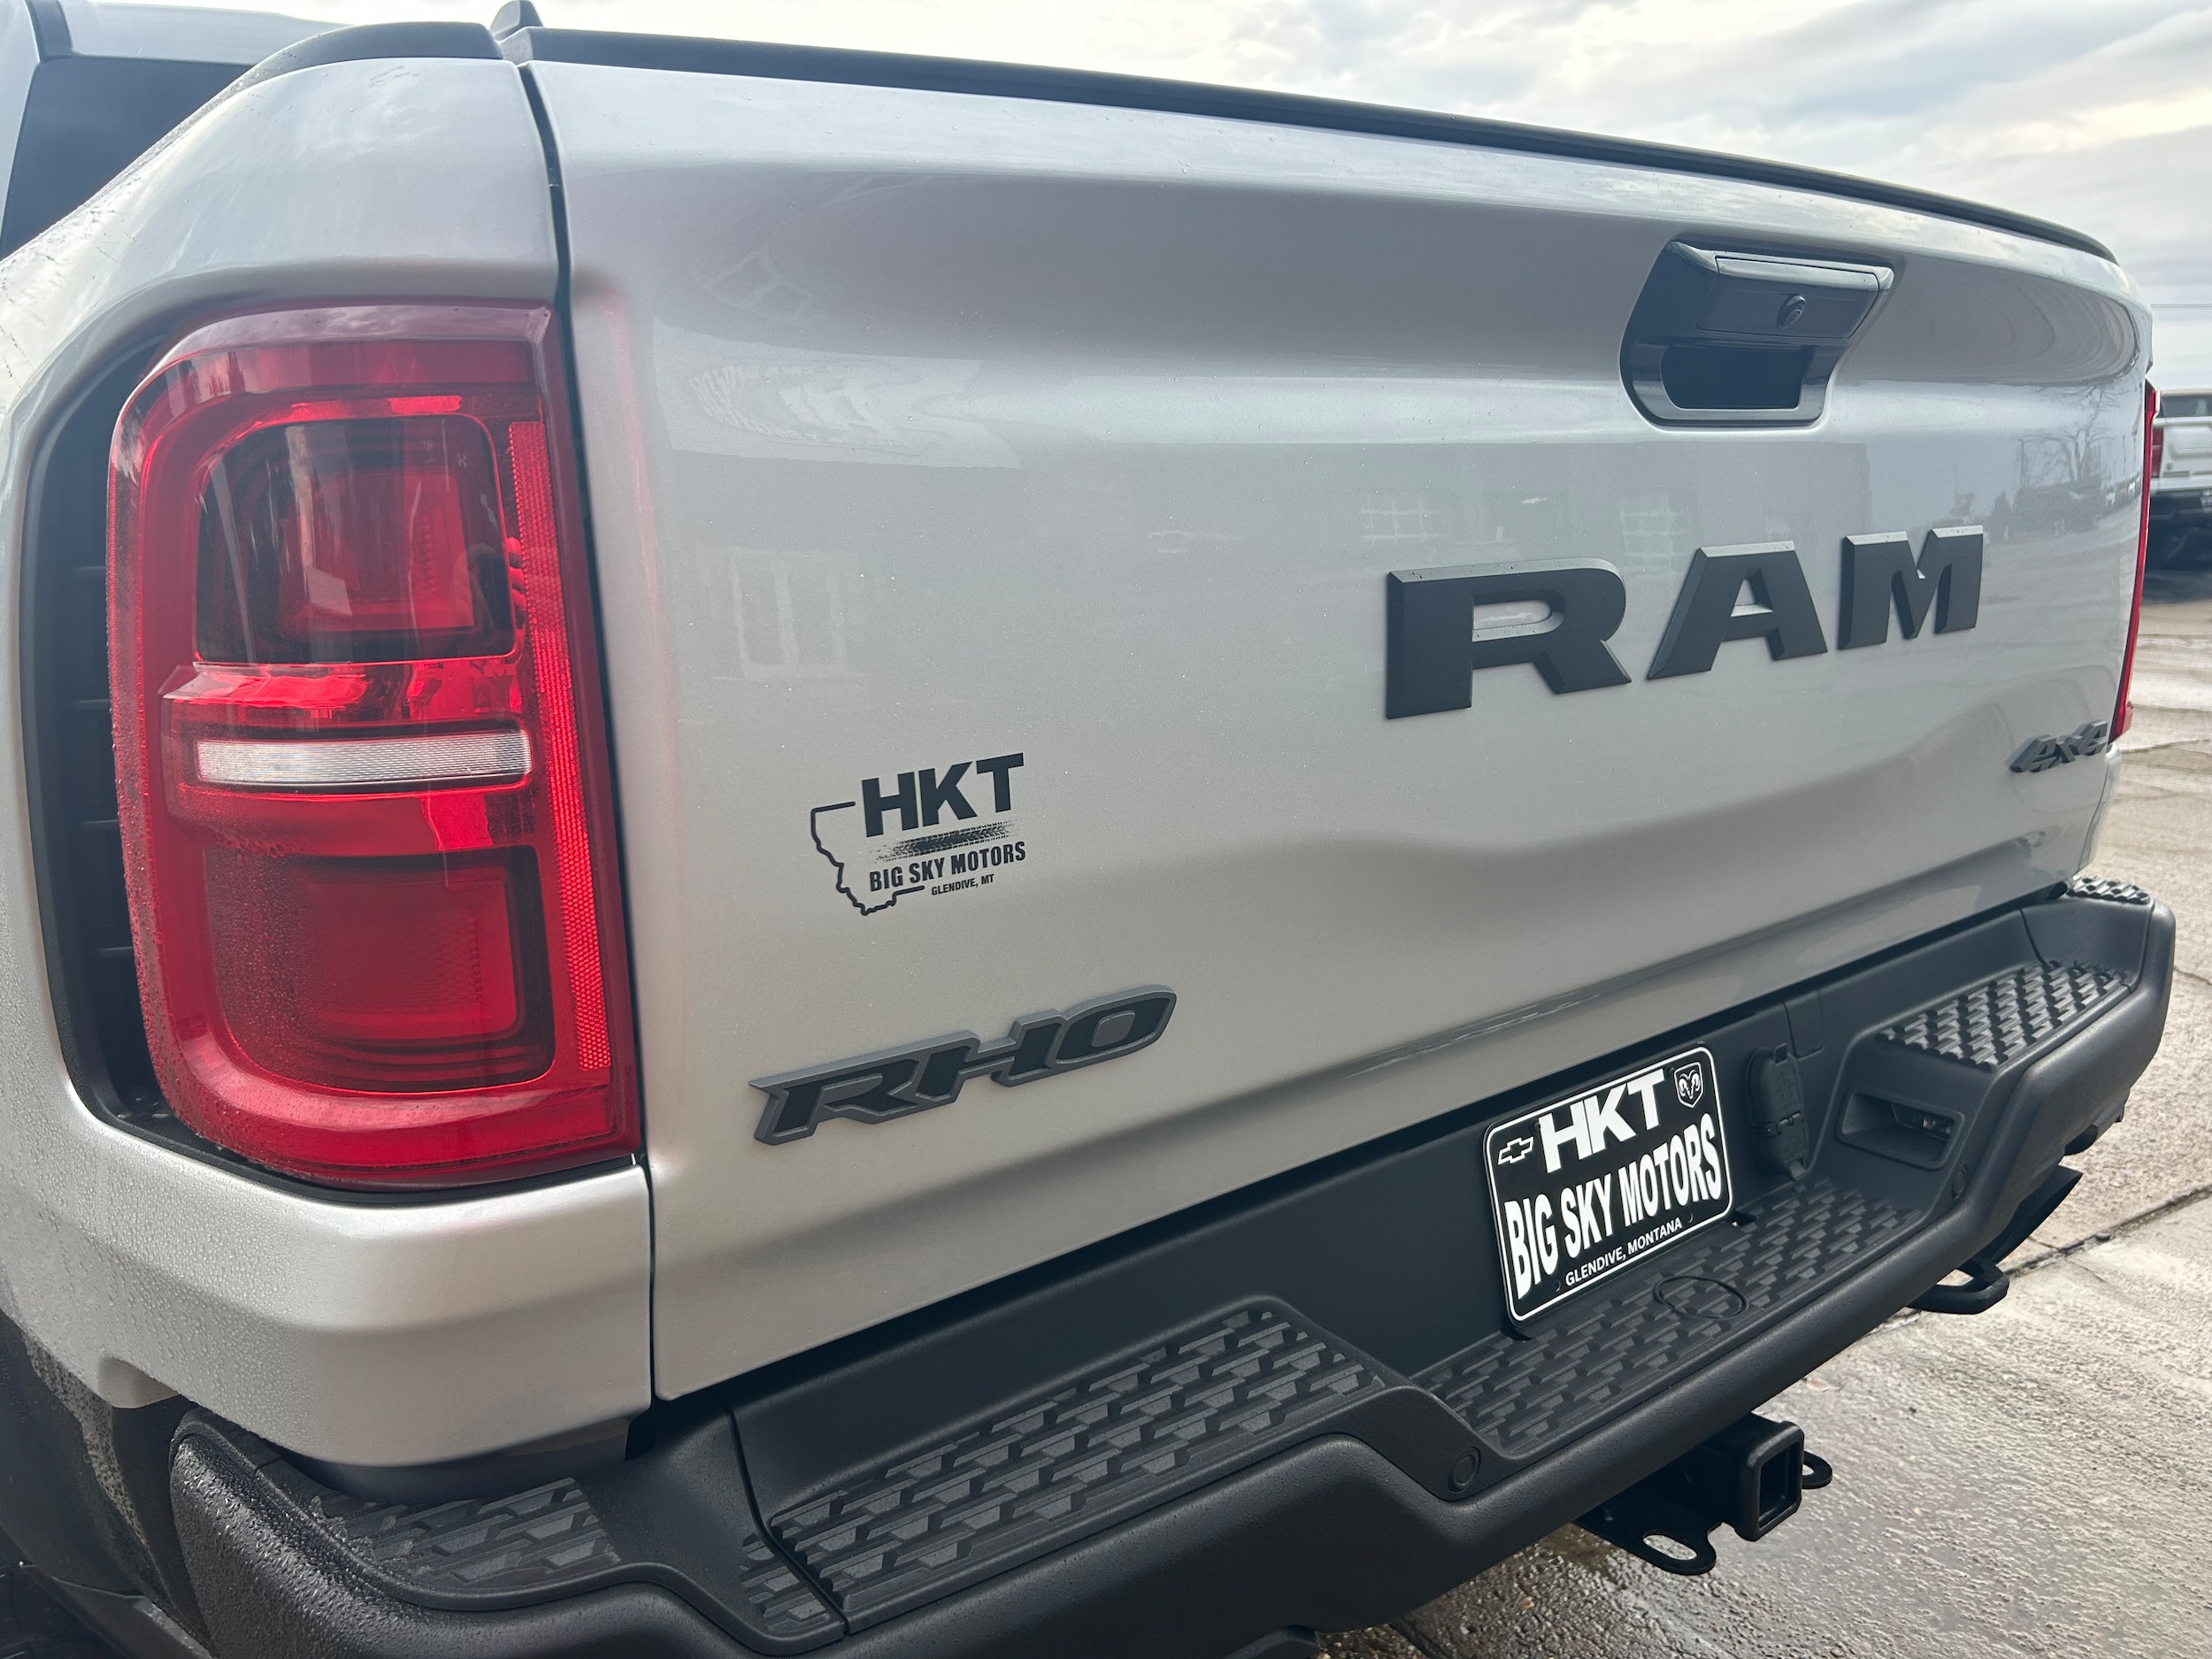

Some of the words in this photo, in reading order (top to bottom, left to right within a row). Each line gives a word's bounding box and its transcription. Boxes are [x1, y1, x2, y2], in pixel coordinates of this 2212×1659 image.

[1386, 525, 1984, 719] RAM
[861, 752, 1025, 838] HKT
[870, 866, 903, 892] BIG
[909, 857, 945, 884] SKY
[950, 841, 1026, 875] MOTORS
[931, 878, 979, 896] GLENDIVE,
[981, 873, 995, 884] MT
[749, 984, 1178, 1146] RHO
[1538, 1068, 1665, 1174] HKT
[1504, 1194, 1560, 1300] BIG
[1560, 1173, 1614, 1259] SKY
[1617, 1113, 1722, 1227] MOTORS
[1565, 1247, 1626, 1286] GLENDIVE,
[1627, 1217, 1682, 1254] MONTANA
